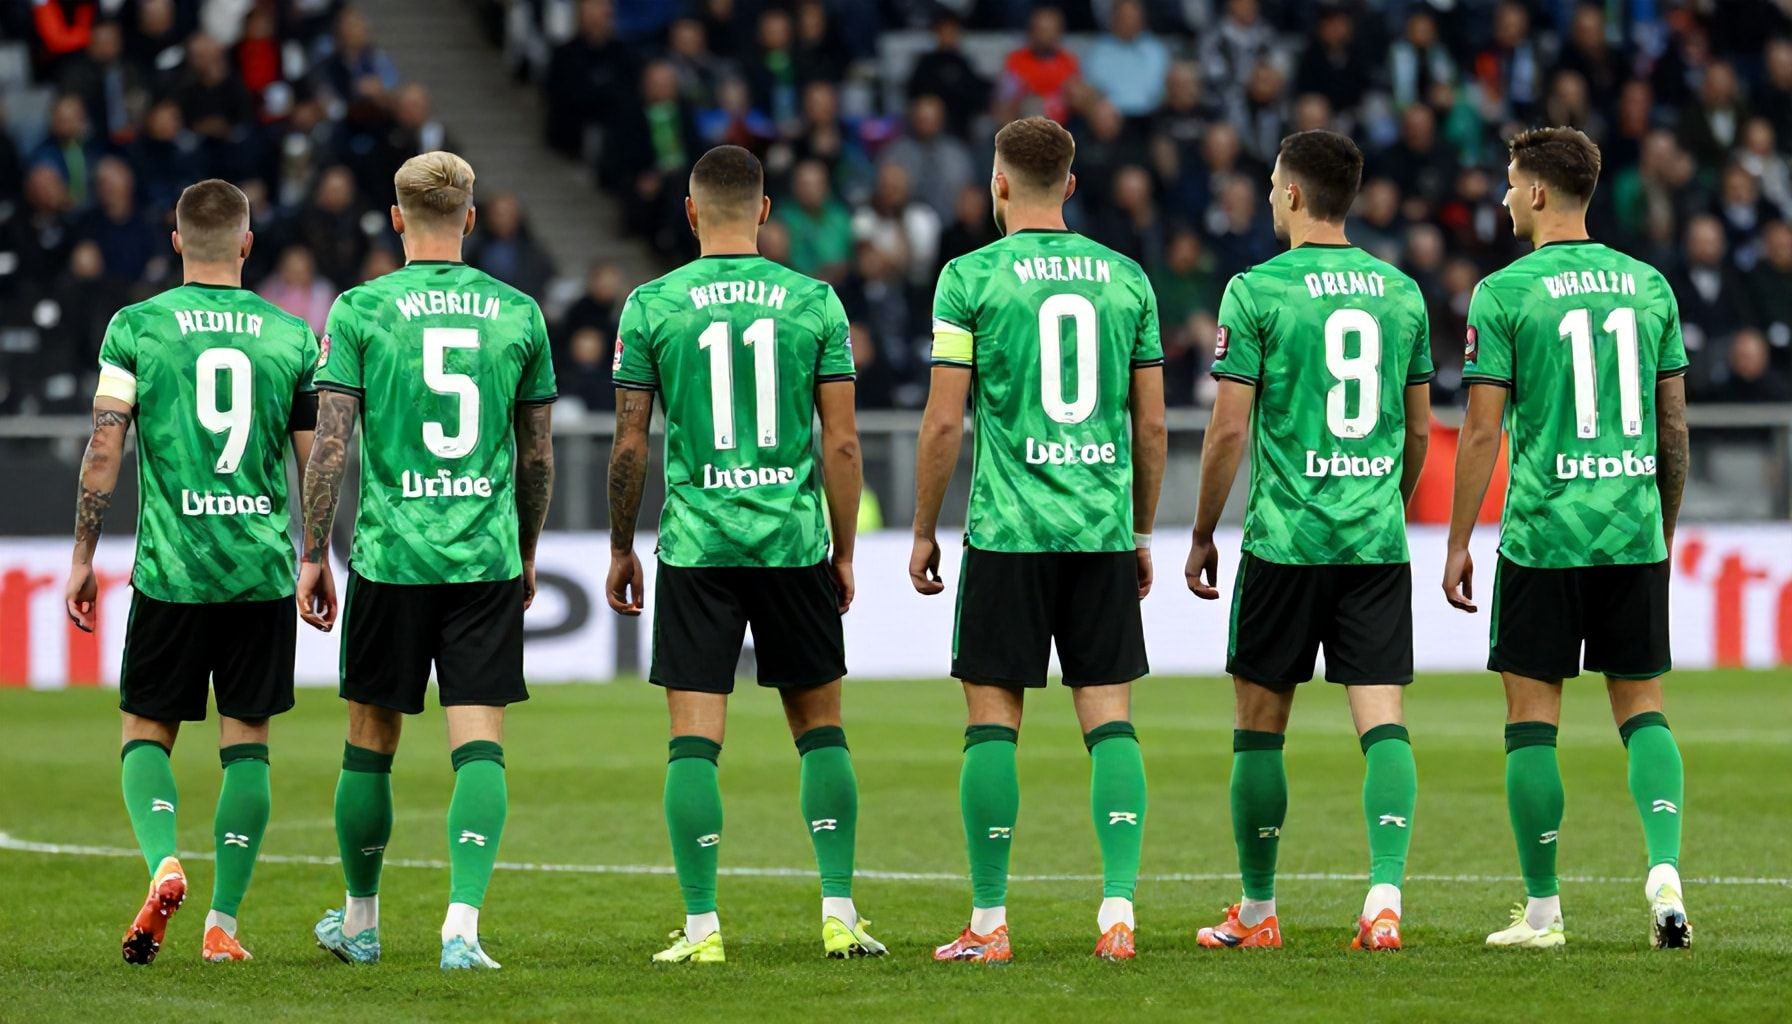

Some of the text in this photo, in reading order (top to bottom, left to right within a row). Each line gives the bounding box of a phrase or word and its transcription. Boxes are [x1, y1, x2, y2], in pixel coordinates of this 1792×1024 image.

[196, 347, 252, 474] 9
[422, 327, 481, 459] 5
[698, 317, 777, 450] 11
[1039, 293, 1098, 424] 0
[1325, 308, 1381, 439] 8
[1558, 307, 1643, 439] 11
